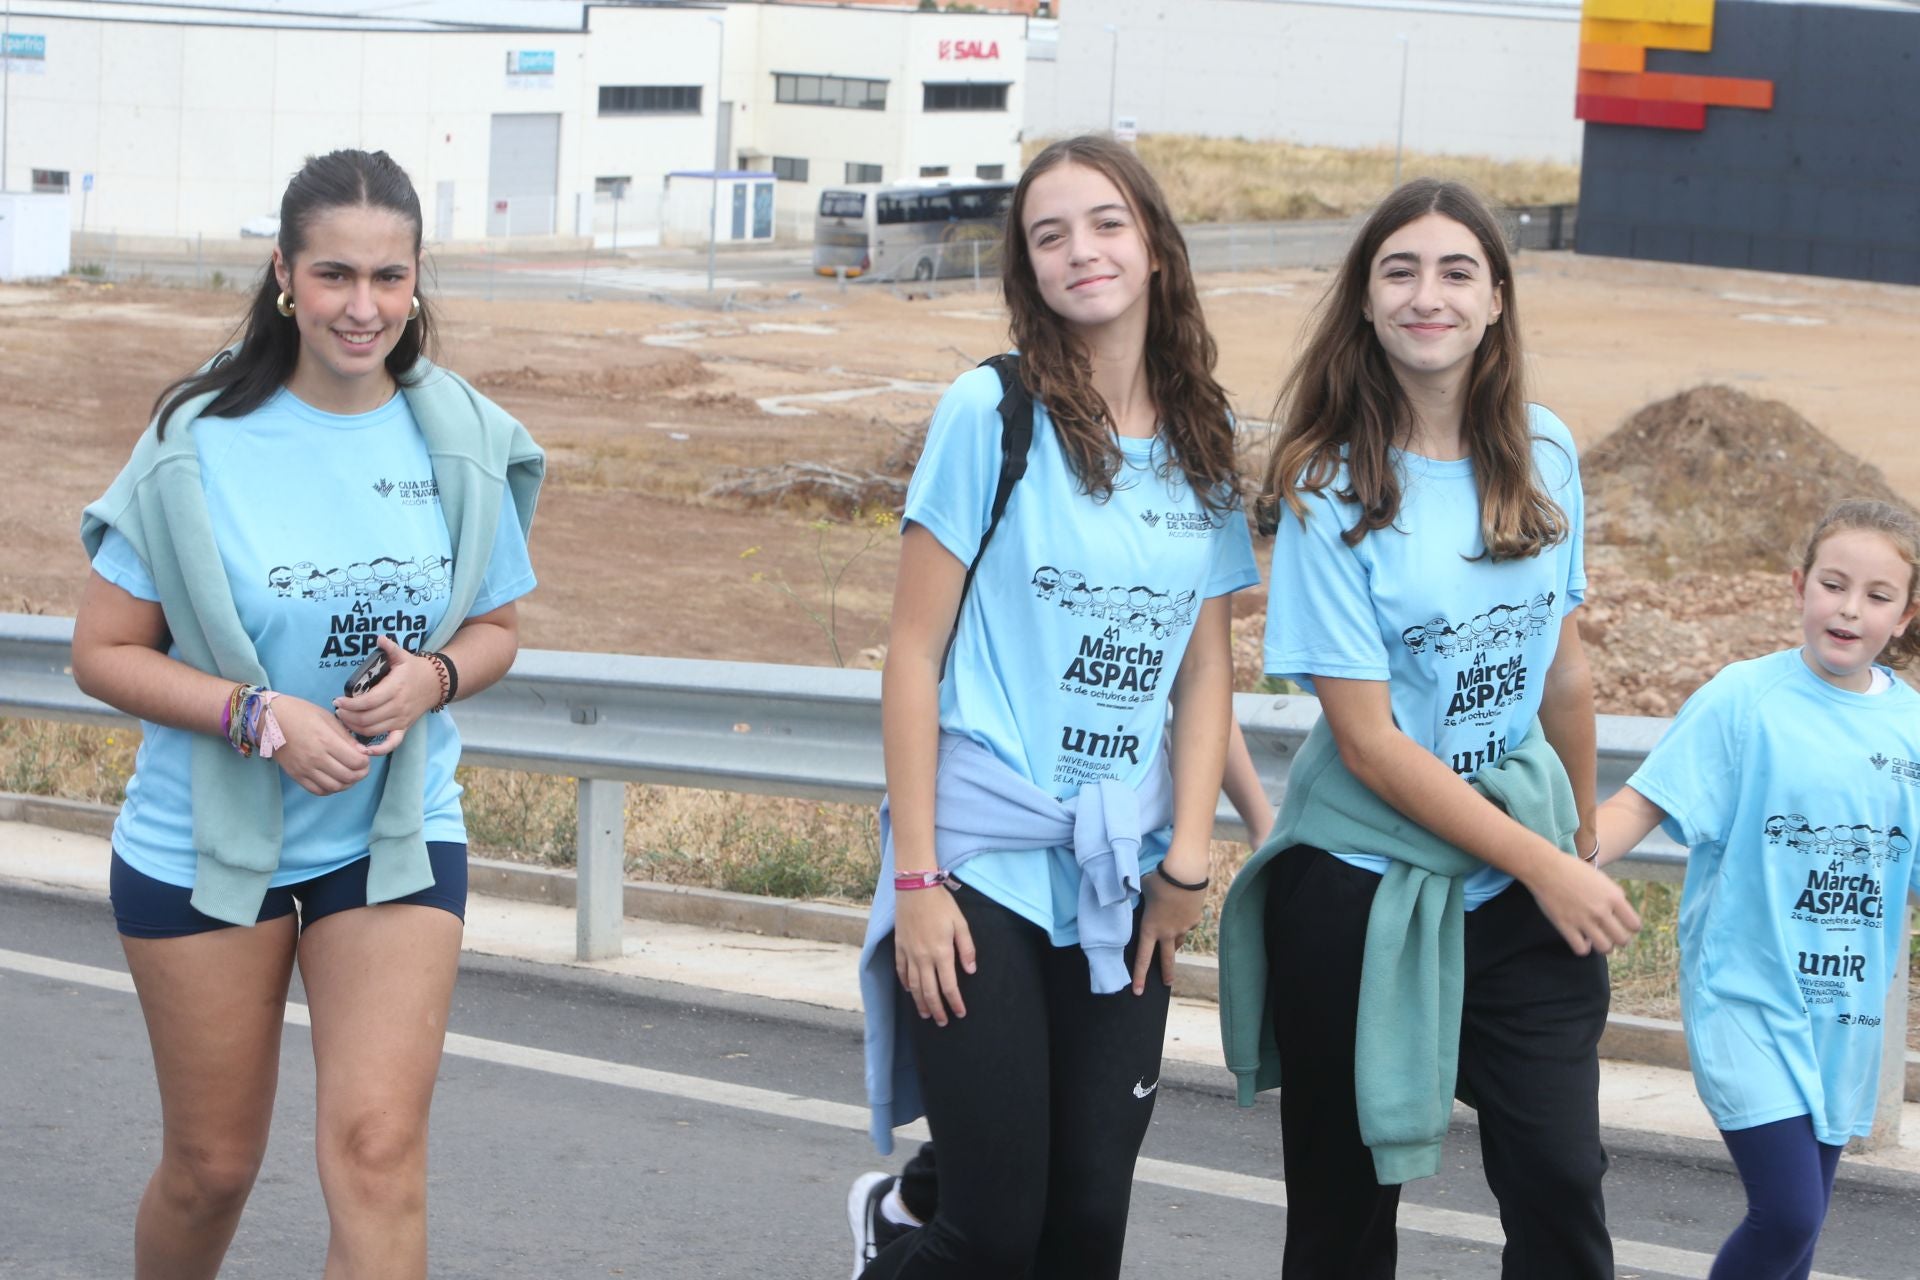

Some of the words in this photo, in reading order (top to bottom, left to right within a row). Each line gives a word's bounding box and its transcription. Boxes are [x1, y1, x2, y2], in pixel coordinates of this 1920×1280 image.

[953, 40, 999, 60] SALA
[400, 489, 411, 498] DE
[352, 600, 373, 616] 41
[330, 610, 428, 634] Marcha
[1102, 625, 1121, 643] 41
[1078, 634, 1164, 667] Marcha
[318, 660, 332, 669] 26
[333, 659, 349, 668] de
[1473, 651, 1487, 668] 41
[1456, 653, 1523, 692] Marcha
[1059, 682, 1073, 692] 26
[1074, 685, 1089, 696] de
[1090, 688, 1127, 703] octubre
[1128, 694, 1140, 704] de
[1443, 718, 1457, 727] 26
[1468, 709, 1501, 721] octub
[1057, 754, 1112, 771] UNIVERSIDAD
[1054, 764, 1121, 781] INTERNACIONAL
[1062, 776, 1075, 786] LA
[1828, 858, 1845, 875] 41
[1807, 869, 1881, 896] Marcha
[1791, 911, 1803, 920] 26
[1804, 914, 1819, 924] de
[1799, 986, 1852, 998] TERNACIONAL
[1857, 1014, 1881, 1028] Rioja
